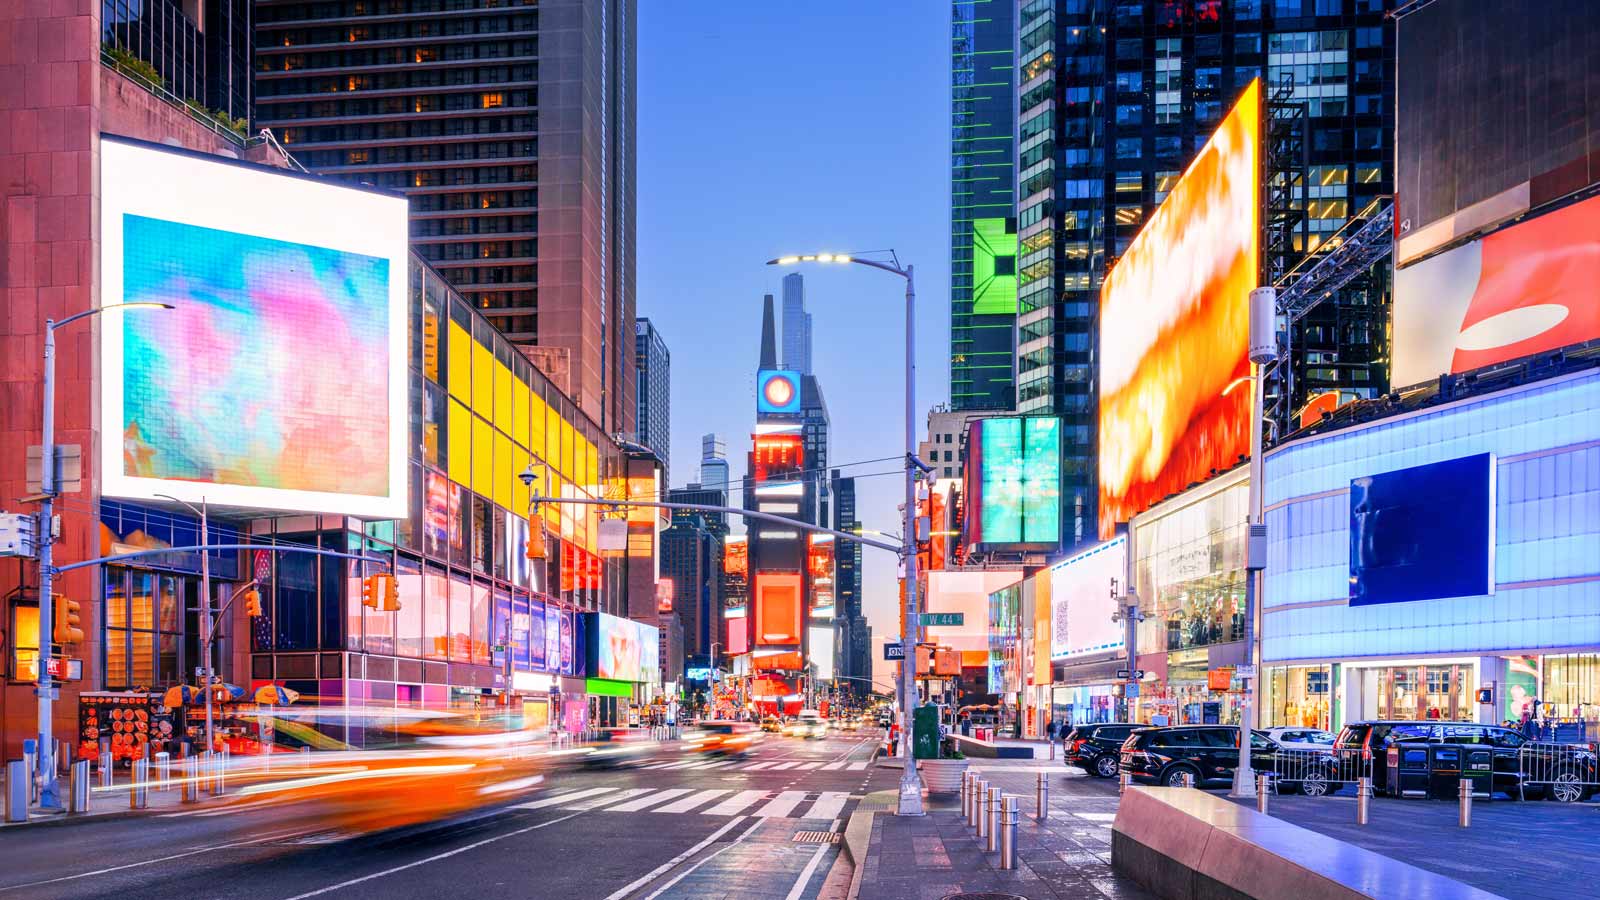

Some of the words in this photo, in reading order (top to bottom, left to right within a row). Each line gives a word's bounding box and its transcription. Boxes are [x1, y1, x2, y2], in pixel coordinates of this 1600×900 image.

[929, 615, 938, 625] W
[942, 614, 953, 625] 44
[890, 648, 903, 656] ON
